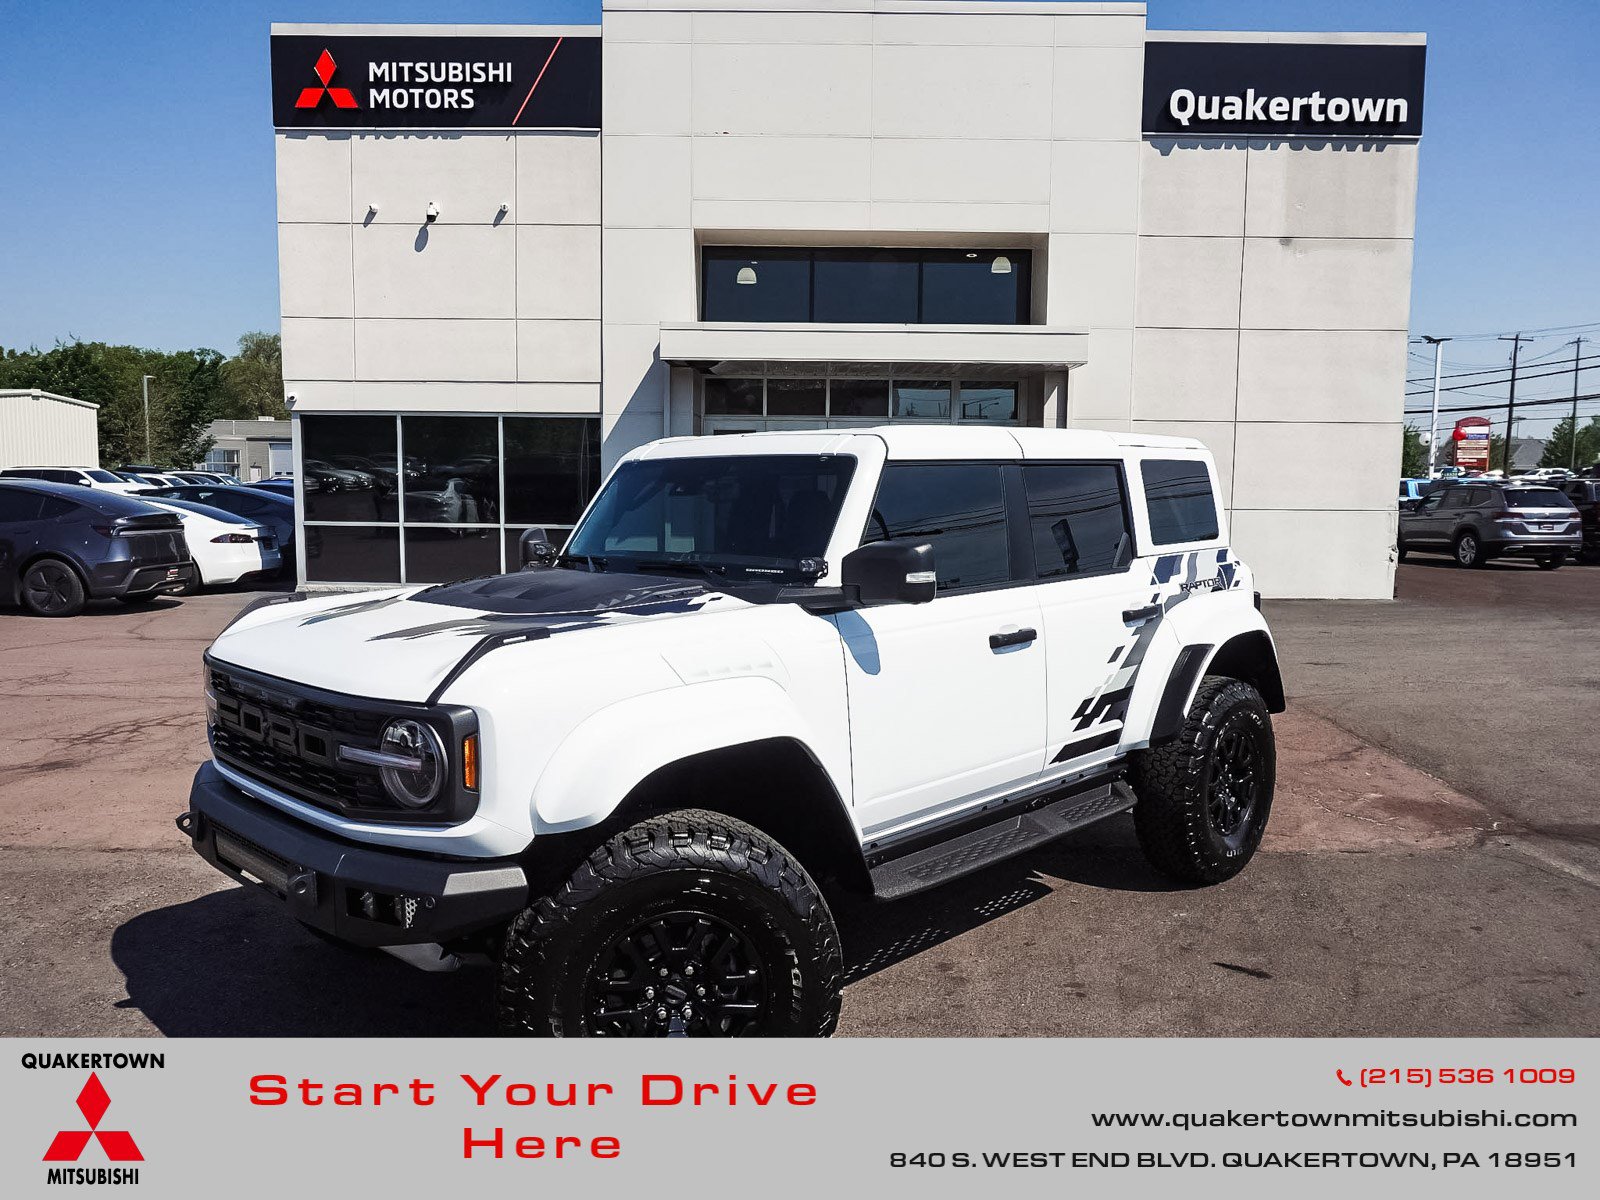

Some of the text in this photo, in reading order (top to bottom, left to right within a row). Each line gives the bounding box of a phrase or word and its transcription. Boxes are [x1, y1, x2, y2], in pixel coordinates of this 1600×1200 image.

[368, 62, 512, 83] MITSUBISHI
[369, 88, 475, 109] MOTORS
[1169, 88, 1408, 126] Quakertown
[1180, 577, 1225, 594] RAPTOR
[215, 693, 337, 767] FORD
